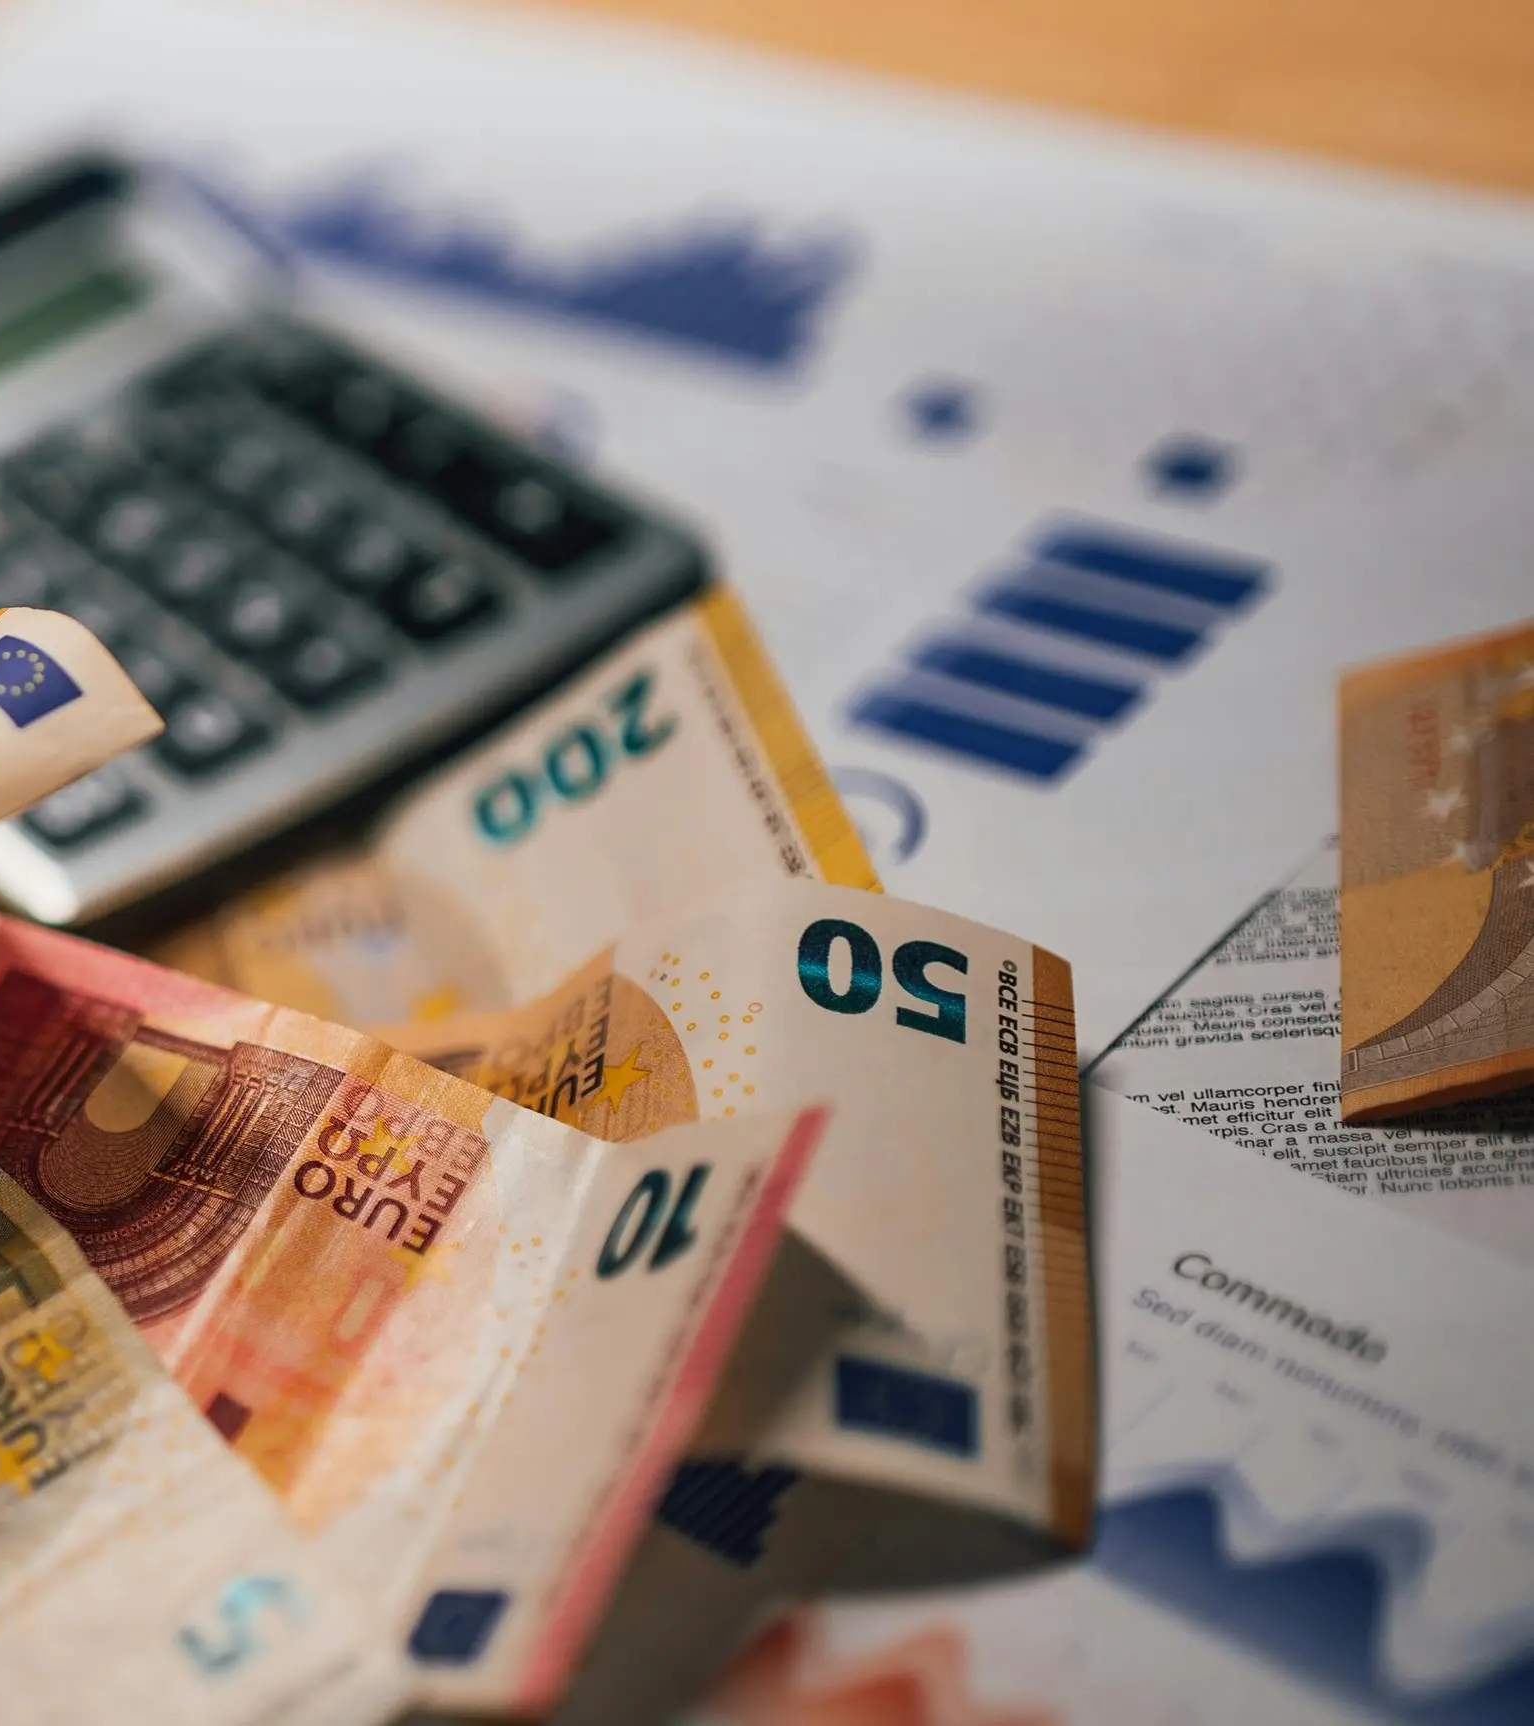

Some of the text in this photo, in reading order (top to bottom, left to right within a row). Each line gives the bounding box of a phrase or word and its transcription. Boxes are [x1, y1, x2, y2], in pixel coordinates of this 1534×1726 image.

[473, 670, 678, 846] 200
[797, 918, 969, 1044] 50
[1300, 1000, 1327, 1013] vel
[1193, 1015, 1257, 1032] Mauris
[998, 1014, 1018, 1056] ECB
[1175, 1032, 1244, 1048] gravida
[1158, 1090, 1185, 1102] vel
[1193, 1084, 1305, 1101] ullamcorper
[1191, 1098, 1255, 1114] Mauris
[1227, 1108, 1295, 1124] efficitur
[1304, 1106, 1333, 1119] elit
[1000, 1105, 1021, 1147] EZB
[1261, 1122, 1308, 1135] Cras
[1314, 1121, 1327, 1132] a
[1285, 1135, 1298, 1147] a
[1308, 1129, 1373, 1145] massa
[1384, 1126, 1413, 1141] vel
[1273, 1147, 1306, 1160] elit,
[1313, 1142, 1387, 1159] suscipit
[1394, 1138, 1468, 1154] semper
[1475, 1132, 1504, 1148] elit
[1344, 1153, 1428, 1170] faucibus
[1432, 1149, 1486, 1166] ligula
[1377, 1163, 1454, 1181] ultricies
[1381, 1177, 1434, 1194] Nunc
[1439, 1173, 1515, 1191] lobortis
[294, 1160, 443, 1256] EURO
[595, 1162, 713, 1280] 10
[1132, 1288, 1194, 1327] Sed
[1194, 1319, 1268, 1363] diam
